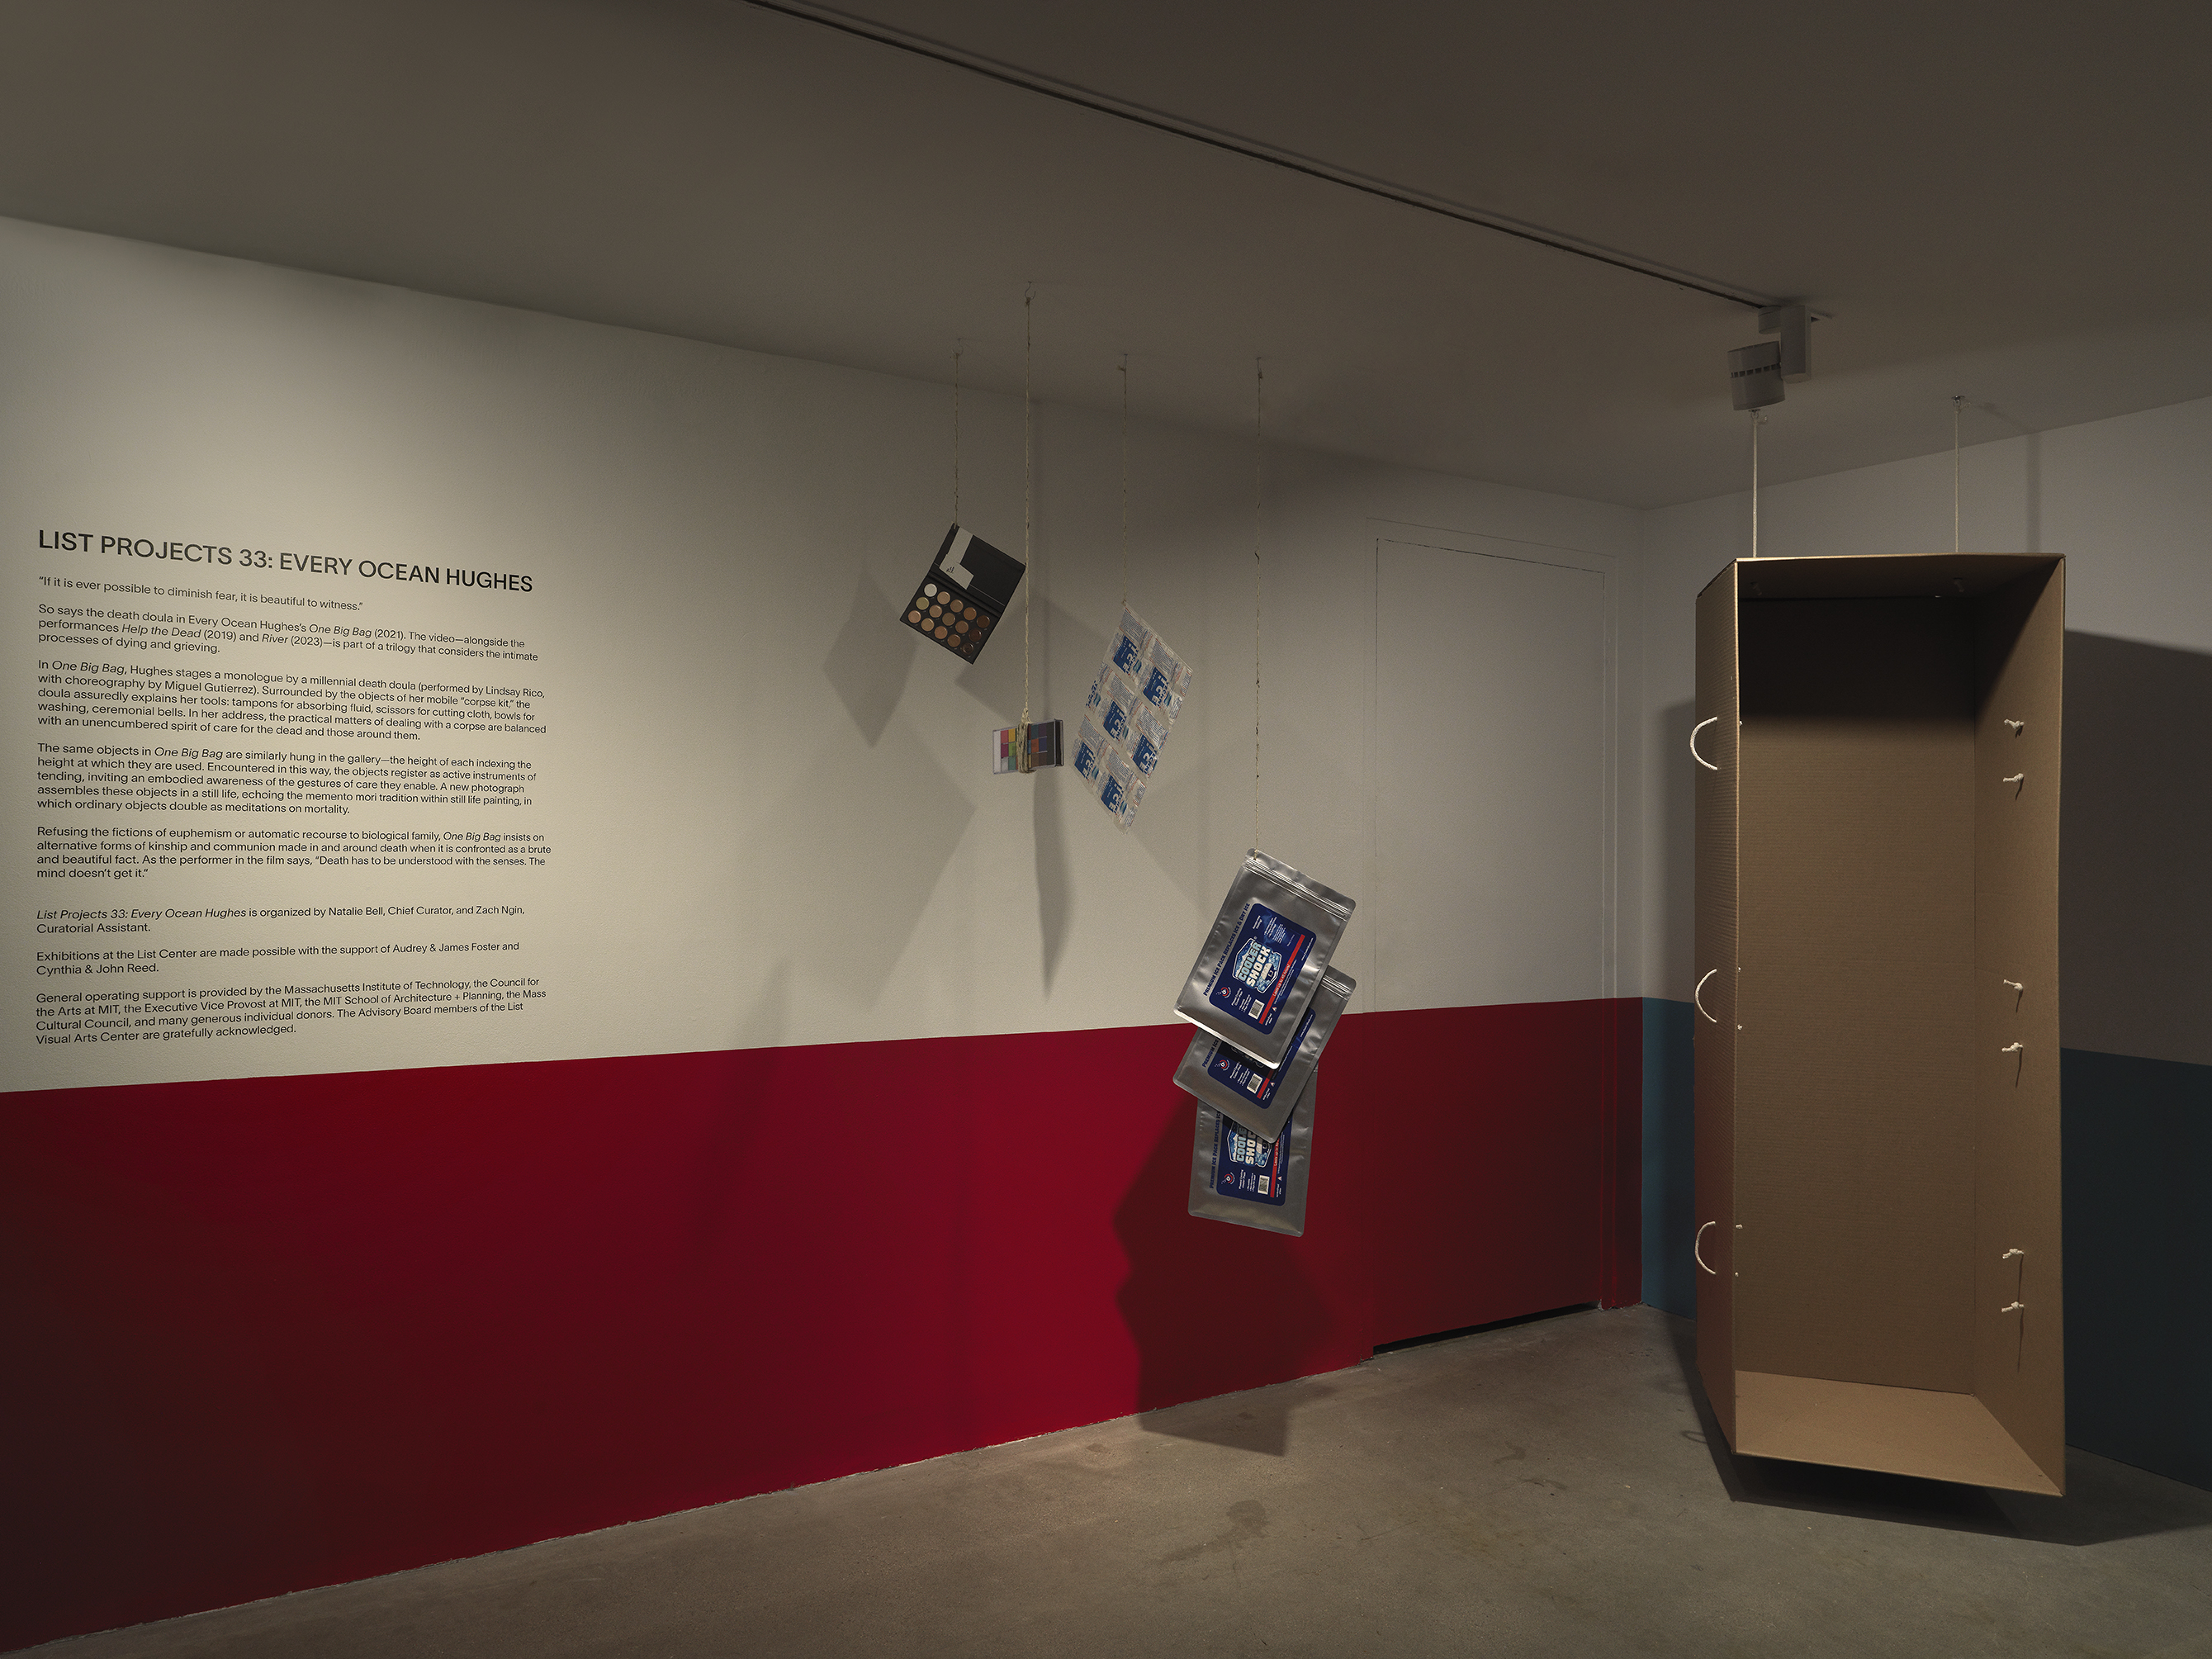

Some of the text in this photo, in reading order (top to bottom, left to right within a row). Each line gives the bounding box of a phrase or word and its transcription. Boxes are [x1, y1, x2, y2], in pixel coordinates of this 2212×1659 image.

[39, 529, 533, 593] LIST PROJECTS 33: EVERY OCEAN HUGHES
[54, 576, 61, 587] it
[64, 577, 73, 589] is
[75, 581, 102, 590] ever
[103, 583, 151, 595] possible
[153, 585, 165, 595] to
[167, 586, 213, 600] diminish
[215, 590, 238, 603] fear,
[240, 592, 247, 602] it
[249, 593, 258, 603] is
[260, 594, 306, 607] beautiful
[306, 598, 318, 608] to
[38, 603, 55, 614] So
[57, 607, 84, 619] says
[85, 607, 105, 619] the
[107, 609, 140, 621] death
[141, 611, 173, 623] doula
[176, 614, 186, 623] in
[188, 614, 219, 628] Every
[220, 617, 258, 629] Ocean
[309, 623, 331, 634] One
[333, 625, 350, 638] Big
[352, 627, 372, 639] Bag
[374, 628, 406, 642] (2021).
[408, 631, 427, 642] The
[510, 638, 525, 648] the
[38, 633, 220, 655] processes of dying and grieving.
[37, 674, 62, 685] with
[64, 675, 146, 691] choreography
[148, 679, 163, 692] by
[164, 680, 202, 693] Miguel
[204, 682, 259, 696] Gutierrez).
[262, 685, 323, 698] Surrounded
[324, 689, 339, 701] by
[339, 690, 357, 699] the
[358, 690, 396, 703] objects
[396, 693, 407, 703] of
[409, 694, 425, 704] her
[426, 695, 459, 705] mobile
[515, 699, 531, 709] the
[36, 770, 525, 795] tending, inviting an embodied awareness of the gestures of care they enable. A new photograph
[36, 799, 350, 816] which ordinary objects double as meditations on mortality.
[36, 868, 66, 879] mind
[113, 869, 133, 880] get
[36, 905, 525, 922] List Projects 33: Every Ocean Hughes is organized by Natalie Bell, Chief Curator, and Zach Ngin,
[36, 922, 151, 934] Curatorial Assistant.
[36, 962, 159, 978] Cynthia & John Reed.
[1238, 941, 1263, 982] COOLER
[1246, 947, 1272, 987] SHOCK
[36, 1024, 296, 1045] Visual Arts Center are gratefully acknowledged.
[1236, 1126, 1248, 1162] COOLE
[1244, 1130, 1257, 1164] SHOC
